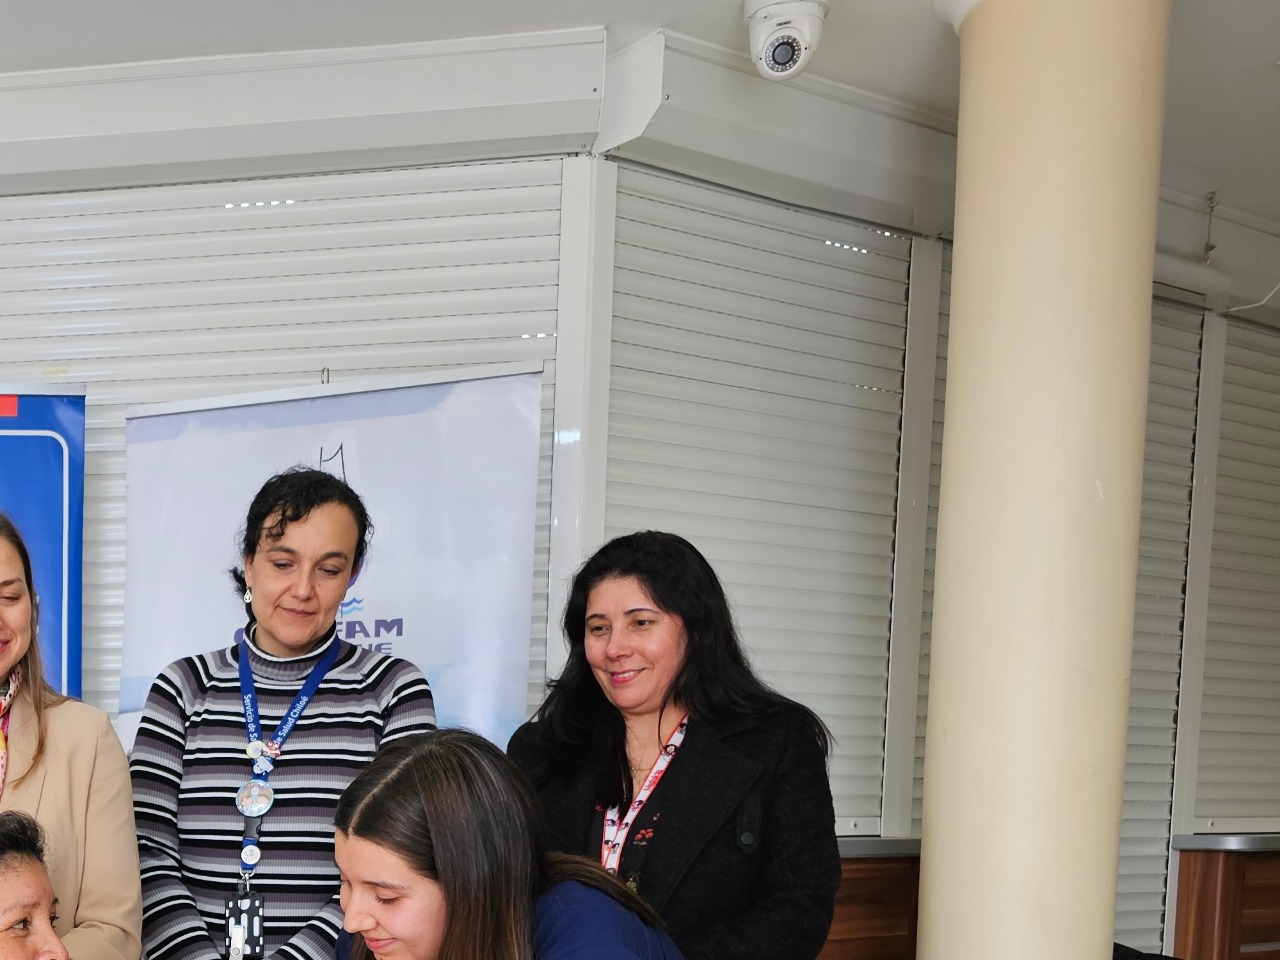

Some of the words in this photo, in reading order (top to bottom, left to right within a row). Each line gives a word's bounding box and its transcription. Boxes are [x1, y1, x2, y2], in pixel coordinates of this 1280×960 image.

[244, 694, 255, 722] Servicio
[278, 717, 295, 737] Salud
[290, 696, 309, 718] Chiloé
[248, 723, 257, 732] de
